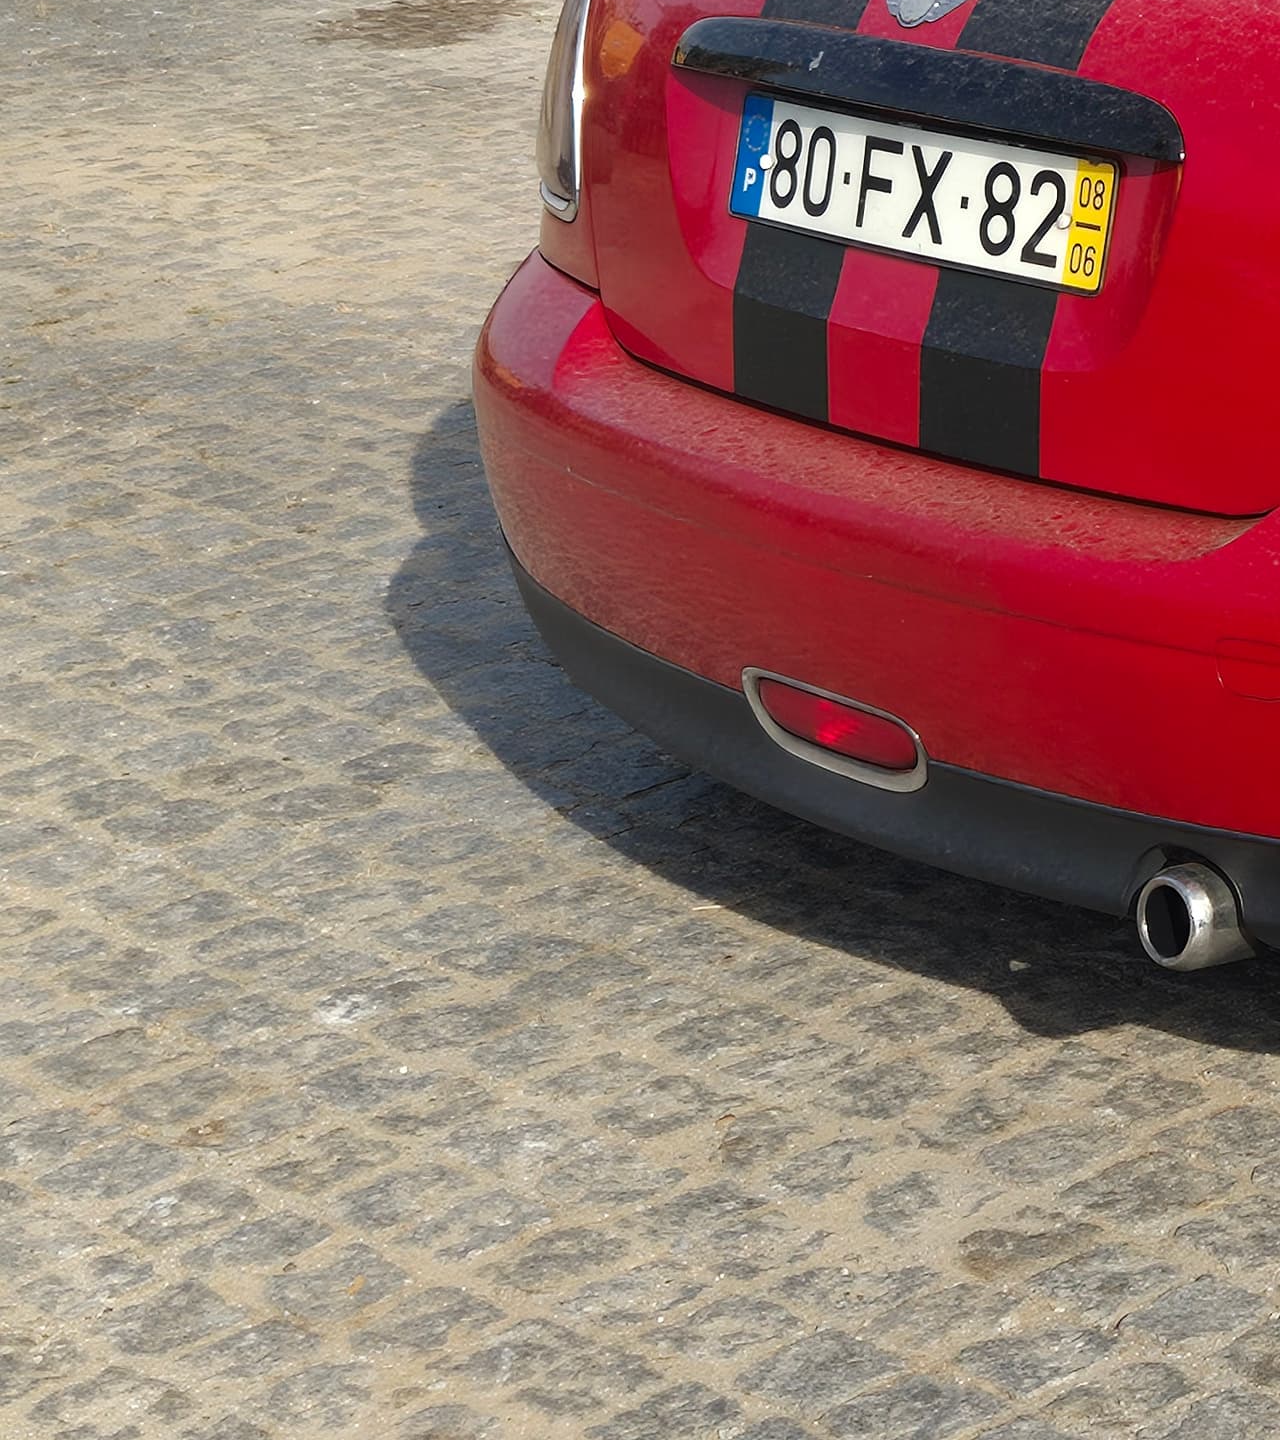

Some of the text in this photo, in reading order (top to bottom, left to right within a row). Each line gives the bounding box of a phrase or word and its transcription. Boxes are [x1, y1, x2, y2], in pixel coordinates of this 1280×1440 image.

[742, 167, 757, 193] P
[1079, 176, 1106, 211] 08
[1069, 242, 1097, 277] 06
